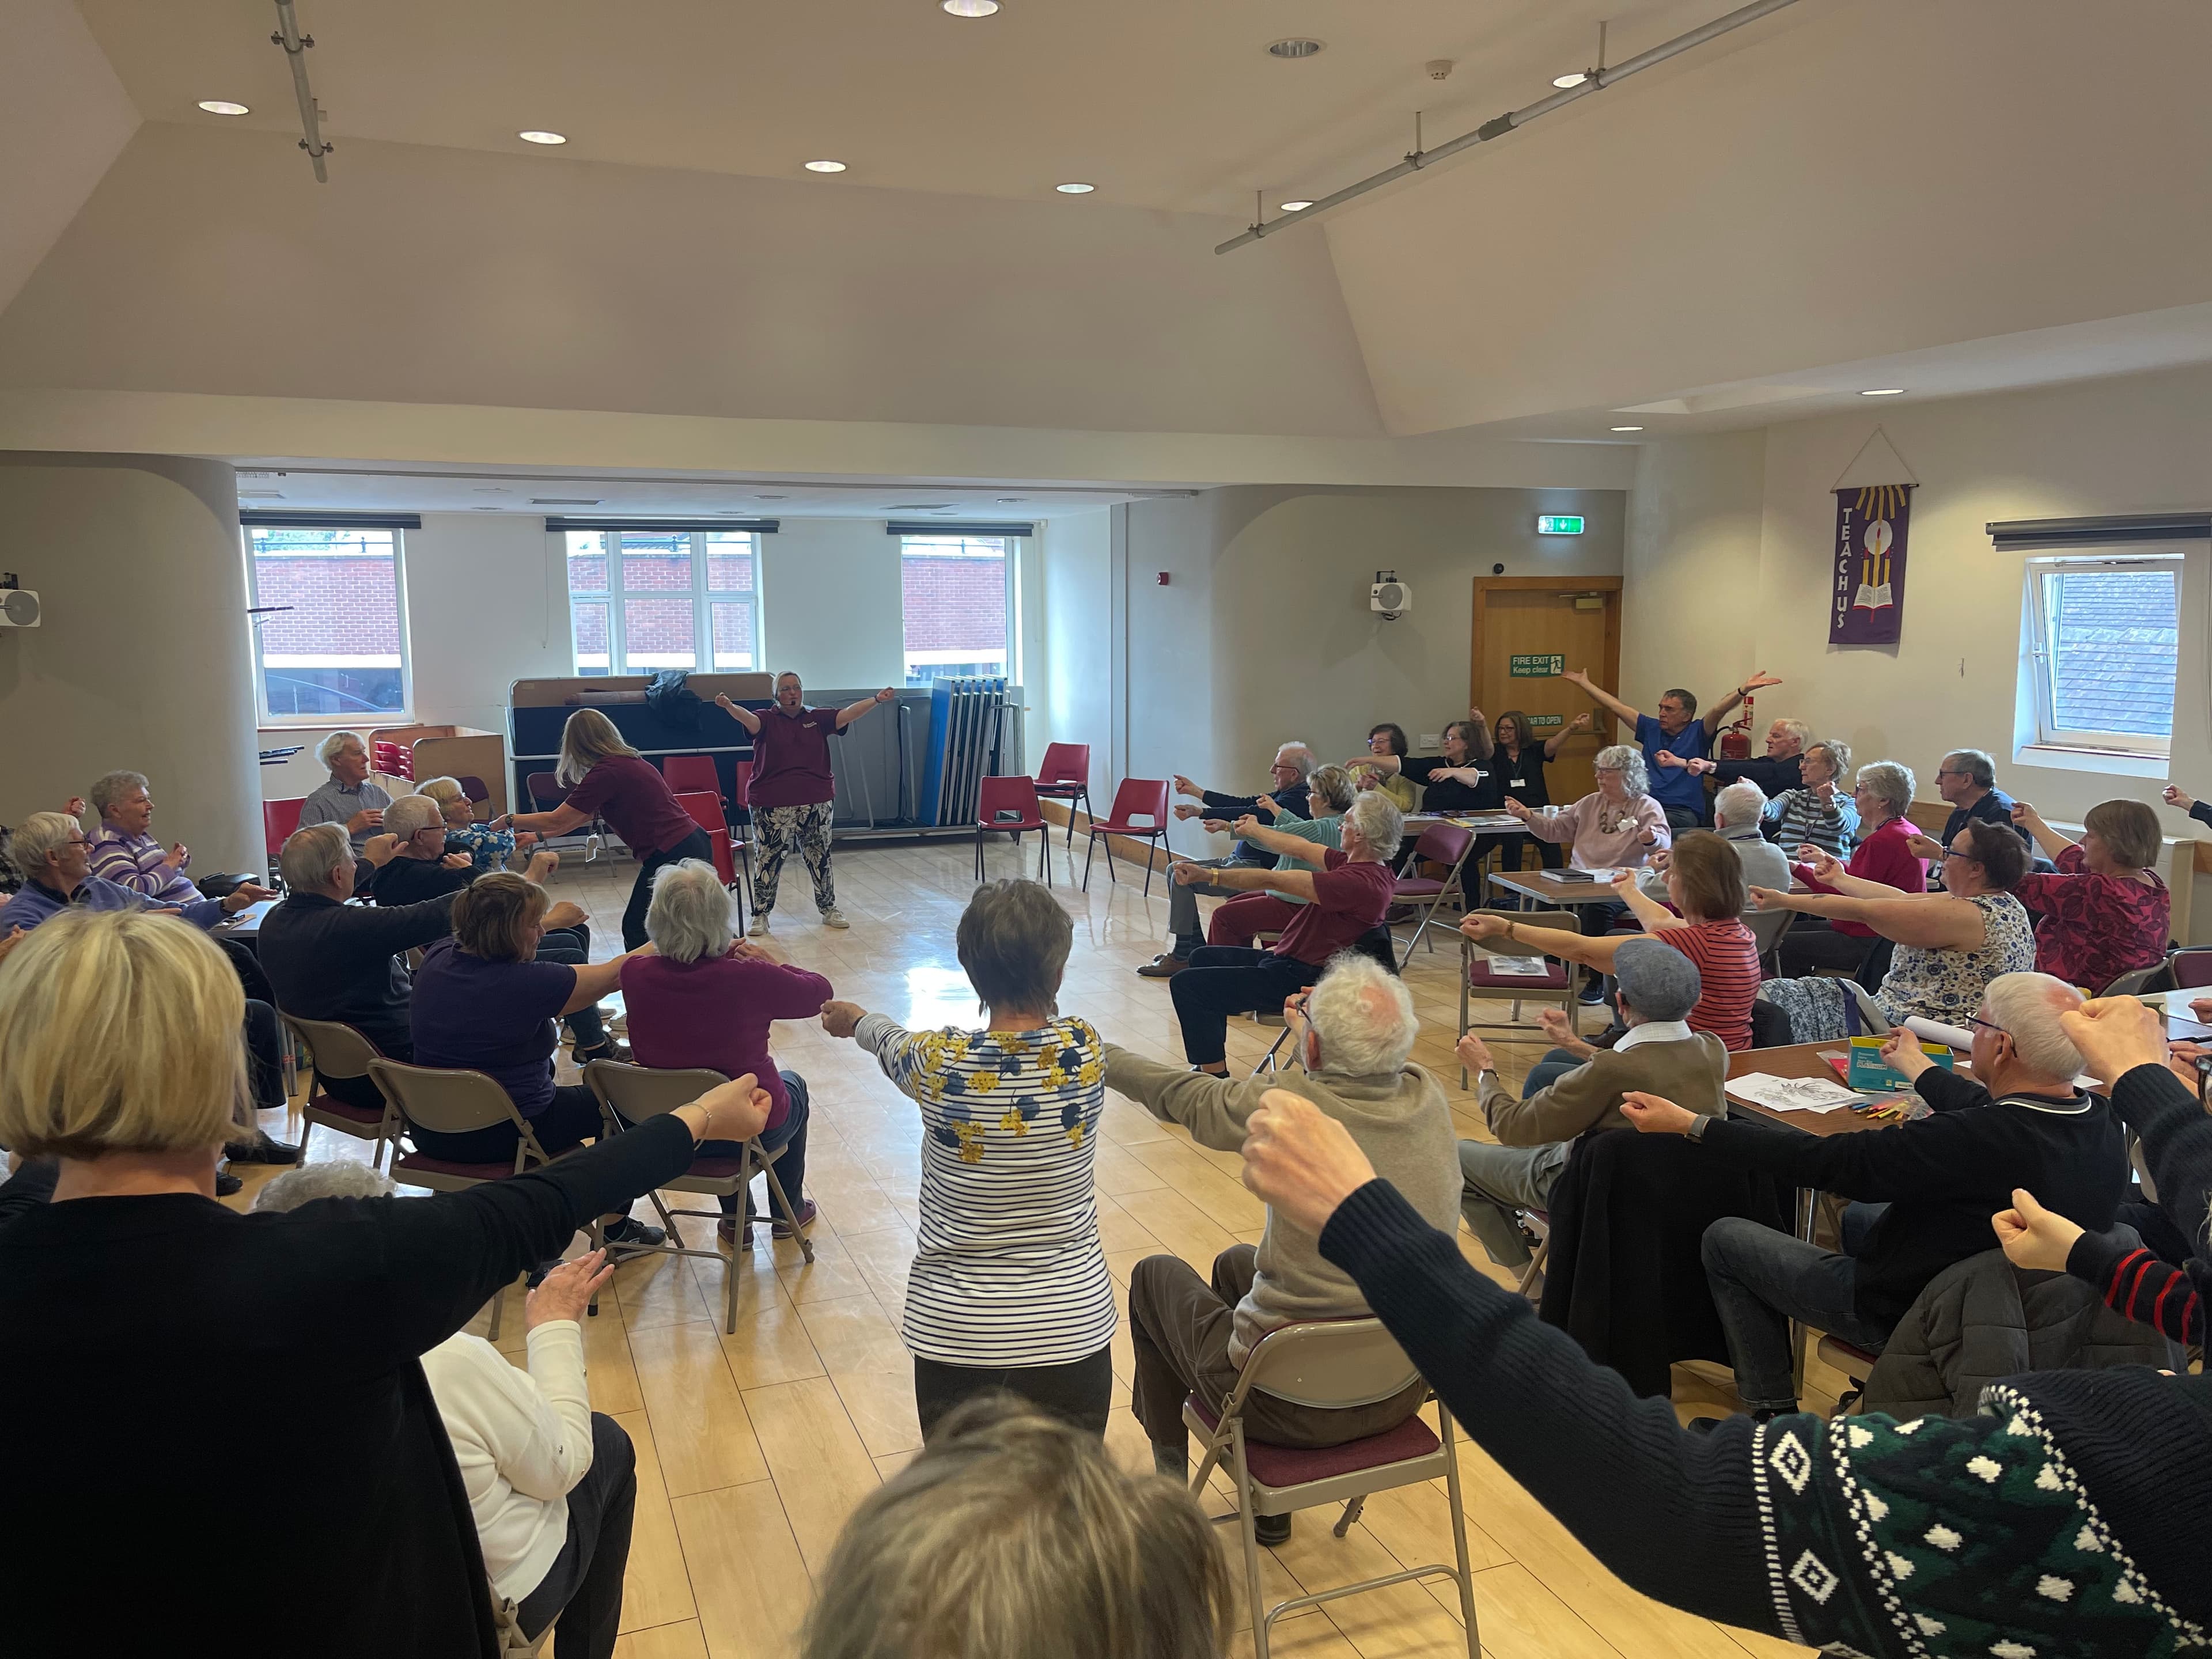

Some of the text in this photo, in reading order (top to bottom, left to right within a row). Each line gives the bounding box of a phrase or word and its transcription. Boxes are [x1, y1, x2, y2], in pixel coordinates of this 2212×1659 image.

[1836, 507, 1853, 629] TEACH US
[1513, 656, 1549, 665] FIRE EXIT
[1513, 666, 1531, 675] Keep
[1527, 716, 1562, 725] AR TO OPEN
